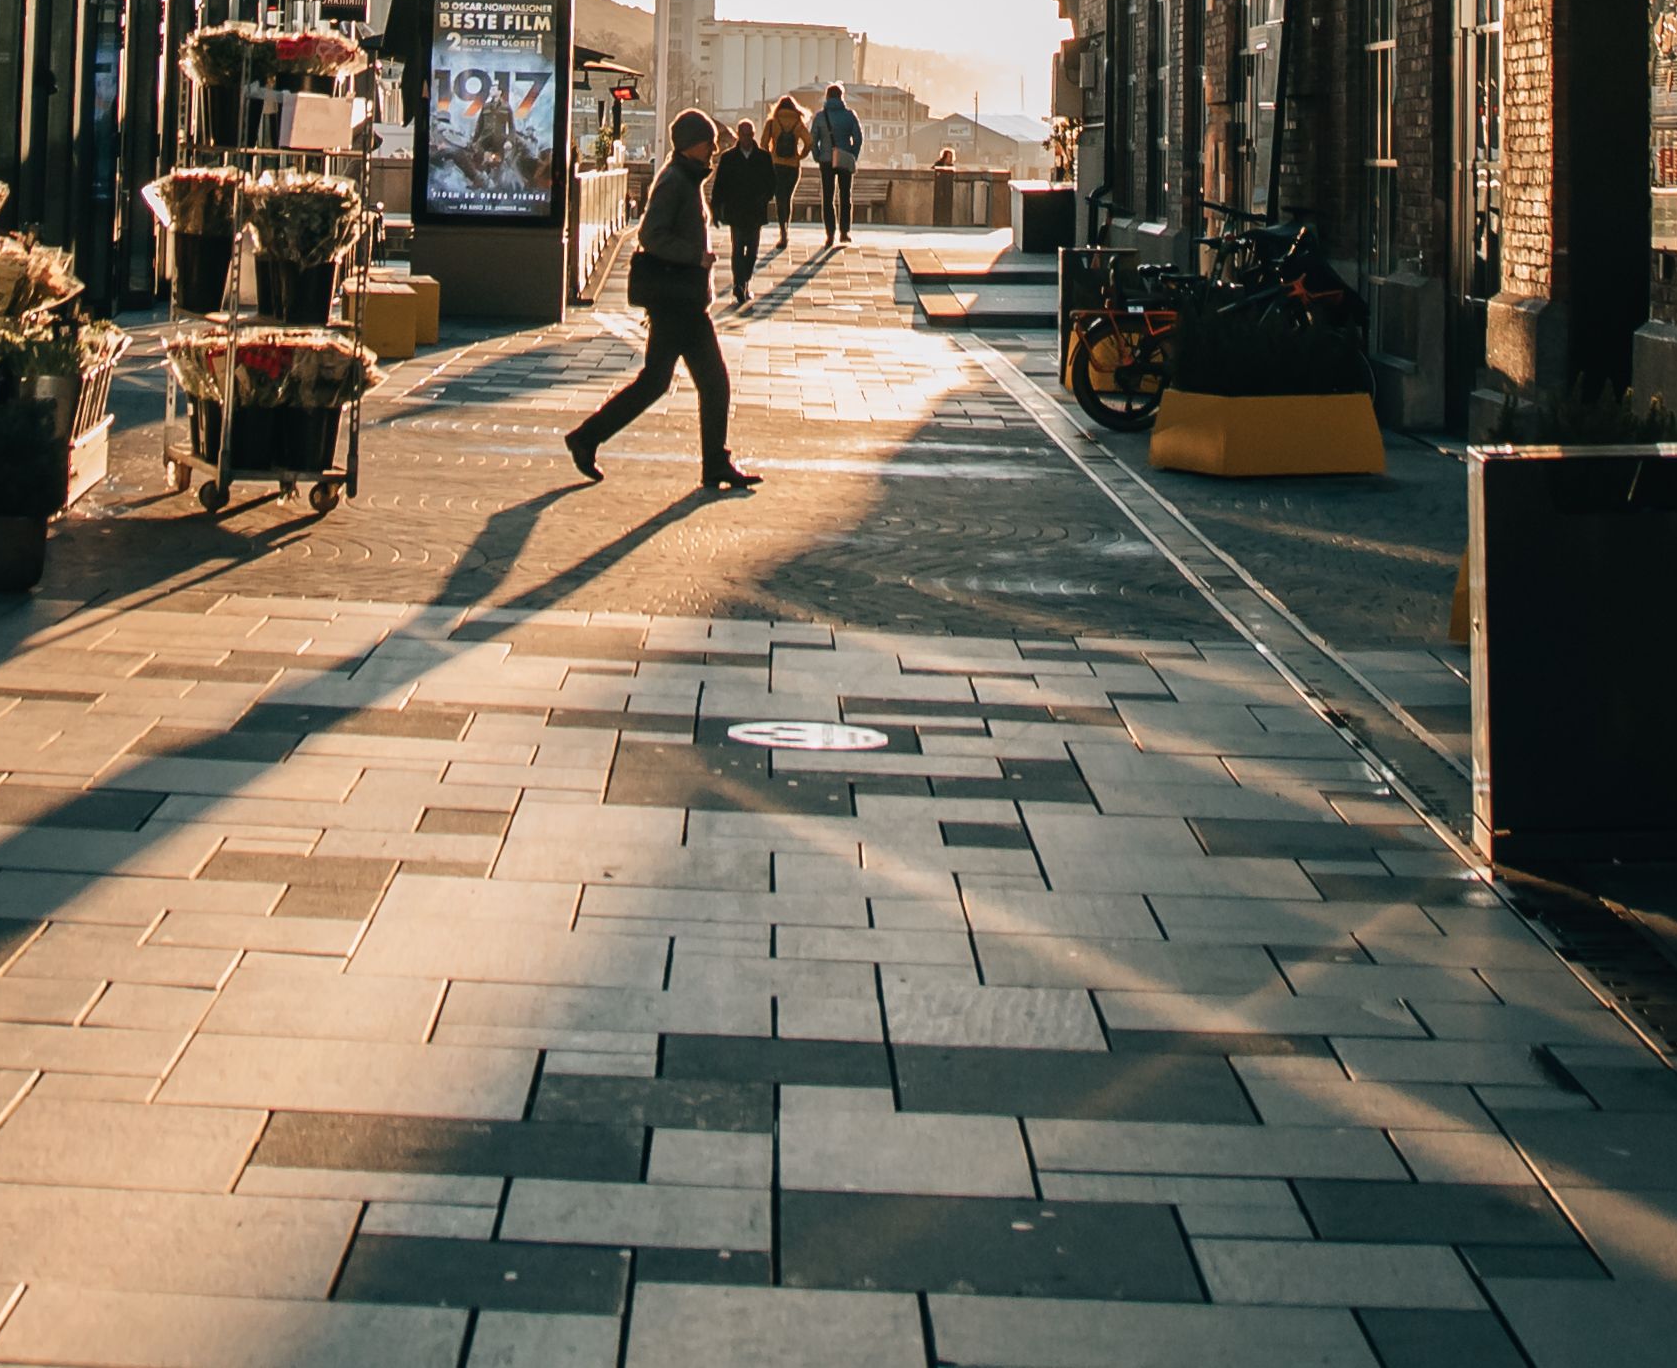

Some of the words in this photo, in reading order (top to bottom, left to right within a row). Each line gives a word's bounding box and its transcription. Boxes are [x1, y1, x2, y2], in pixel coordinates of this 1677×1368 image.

[439, 2, 450, 10] 10
[439, 13, 498, 30] BESTE
[503, 15, 552, 32] FILM
[446, 32, 461, 52] 2
[461, 38, 499, 47] GOLDEN
[434, 68, 553, 120] 1917
